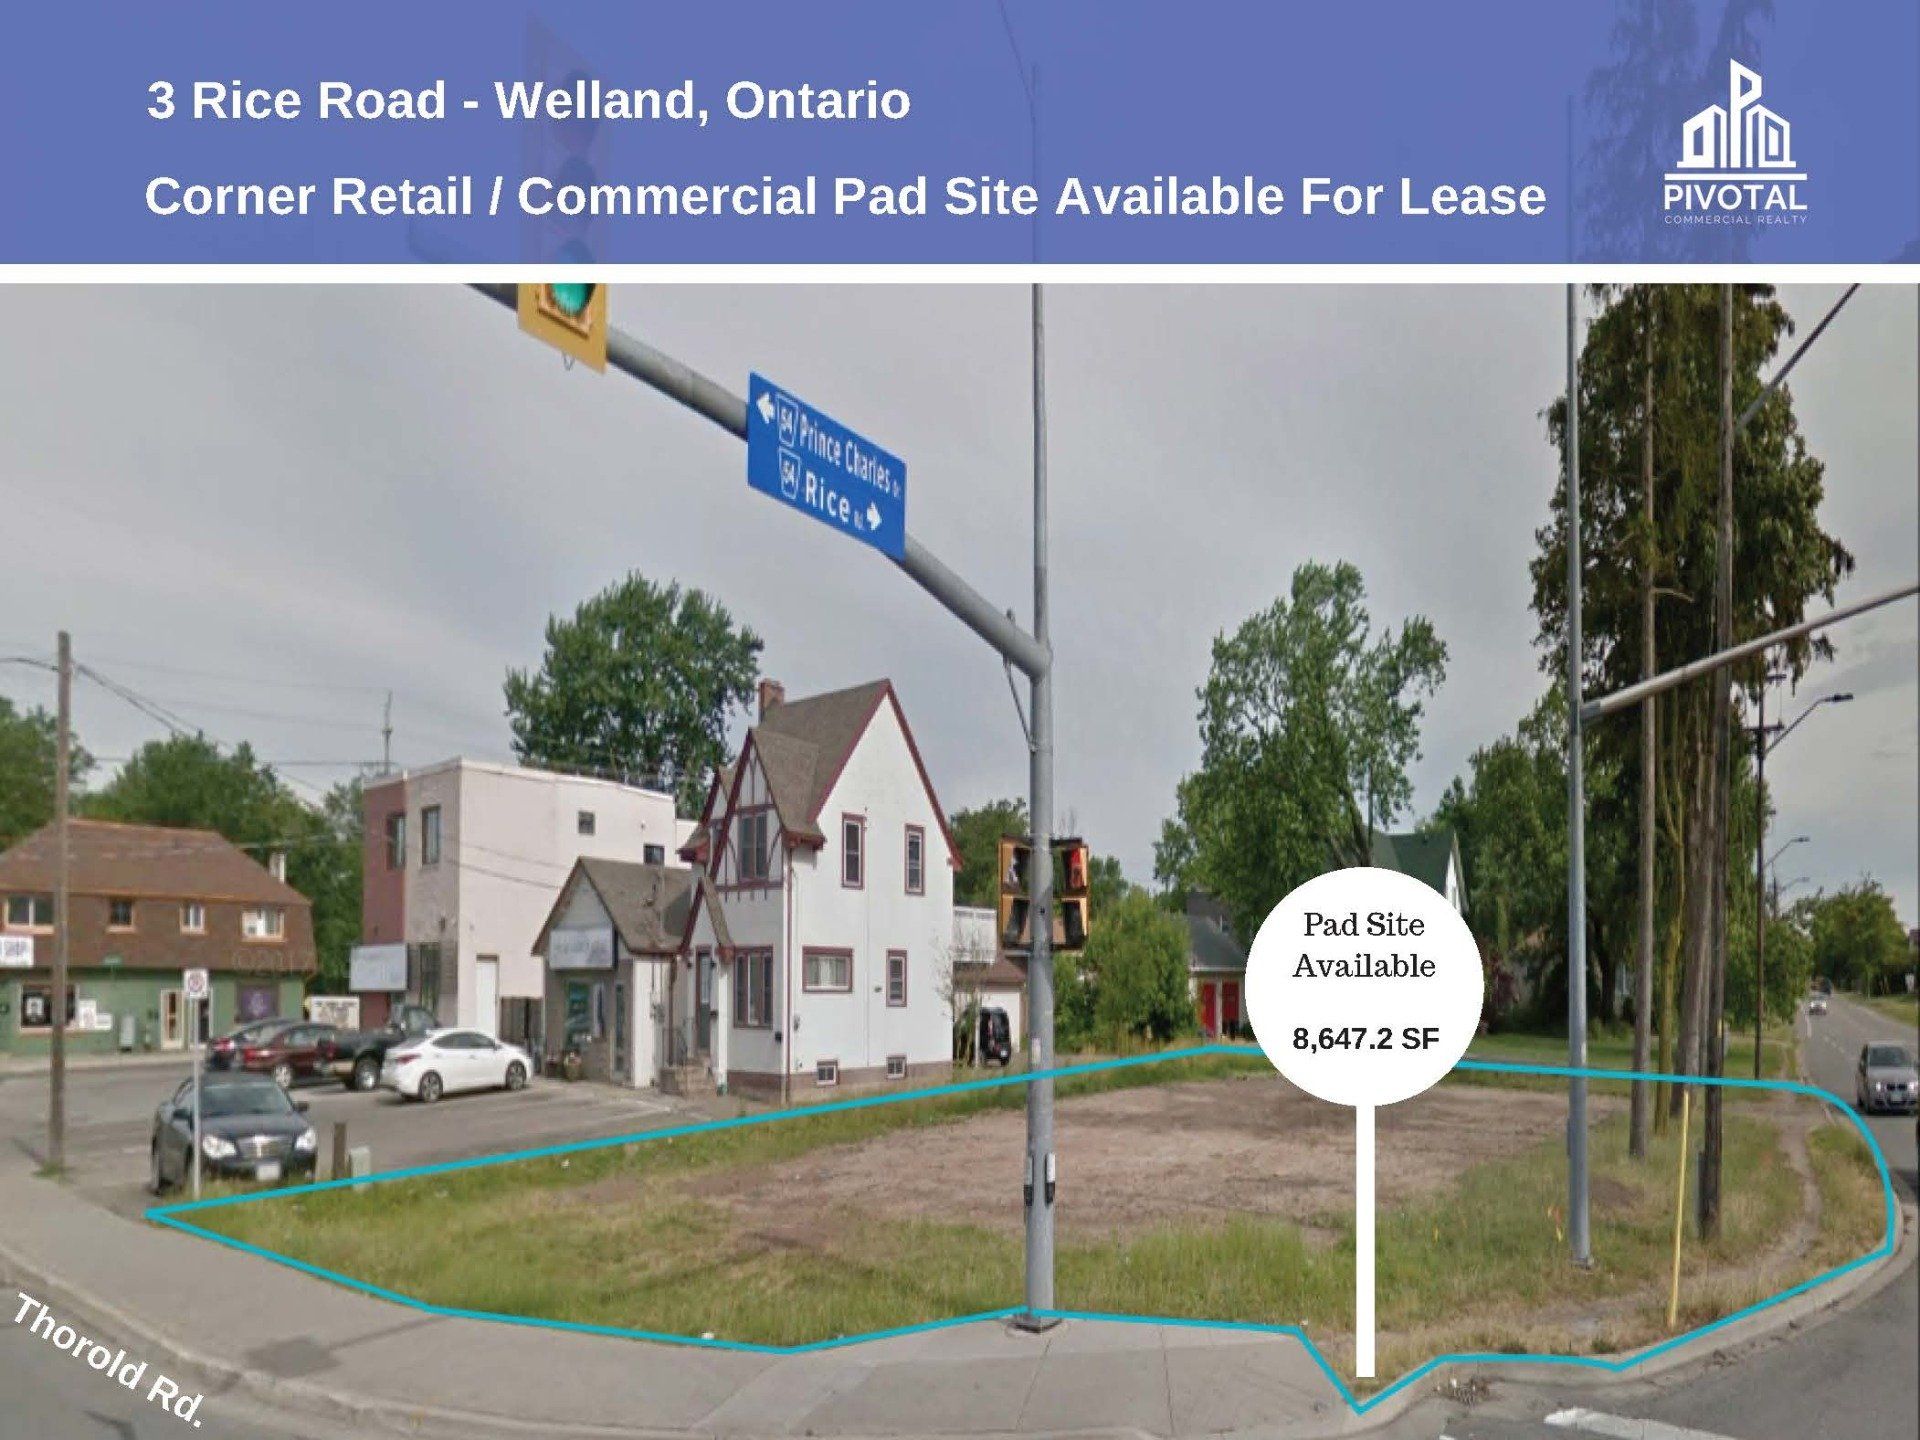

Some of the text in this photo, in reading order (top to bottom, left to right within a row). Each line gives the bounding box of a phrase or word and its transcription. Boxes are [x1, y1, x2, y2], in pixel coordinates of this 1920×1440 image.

[800, 413, 841, 467] Prince
[845, 440, 890, 494] Charles
[805, 470, 850, 523] Rice
